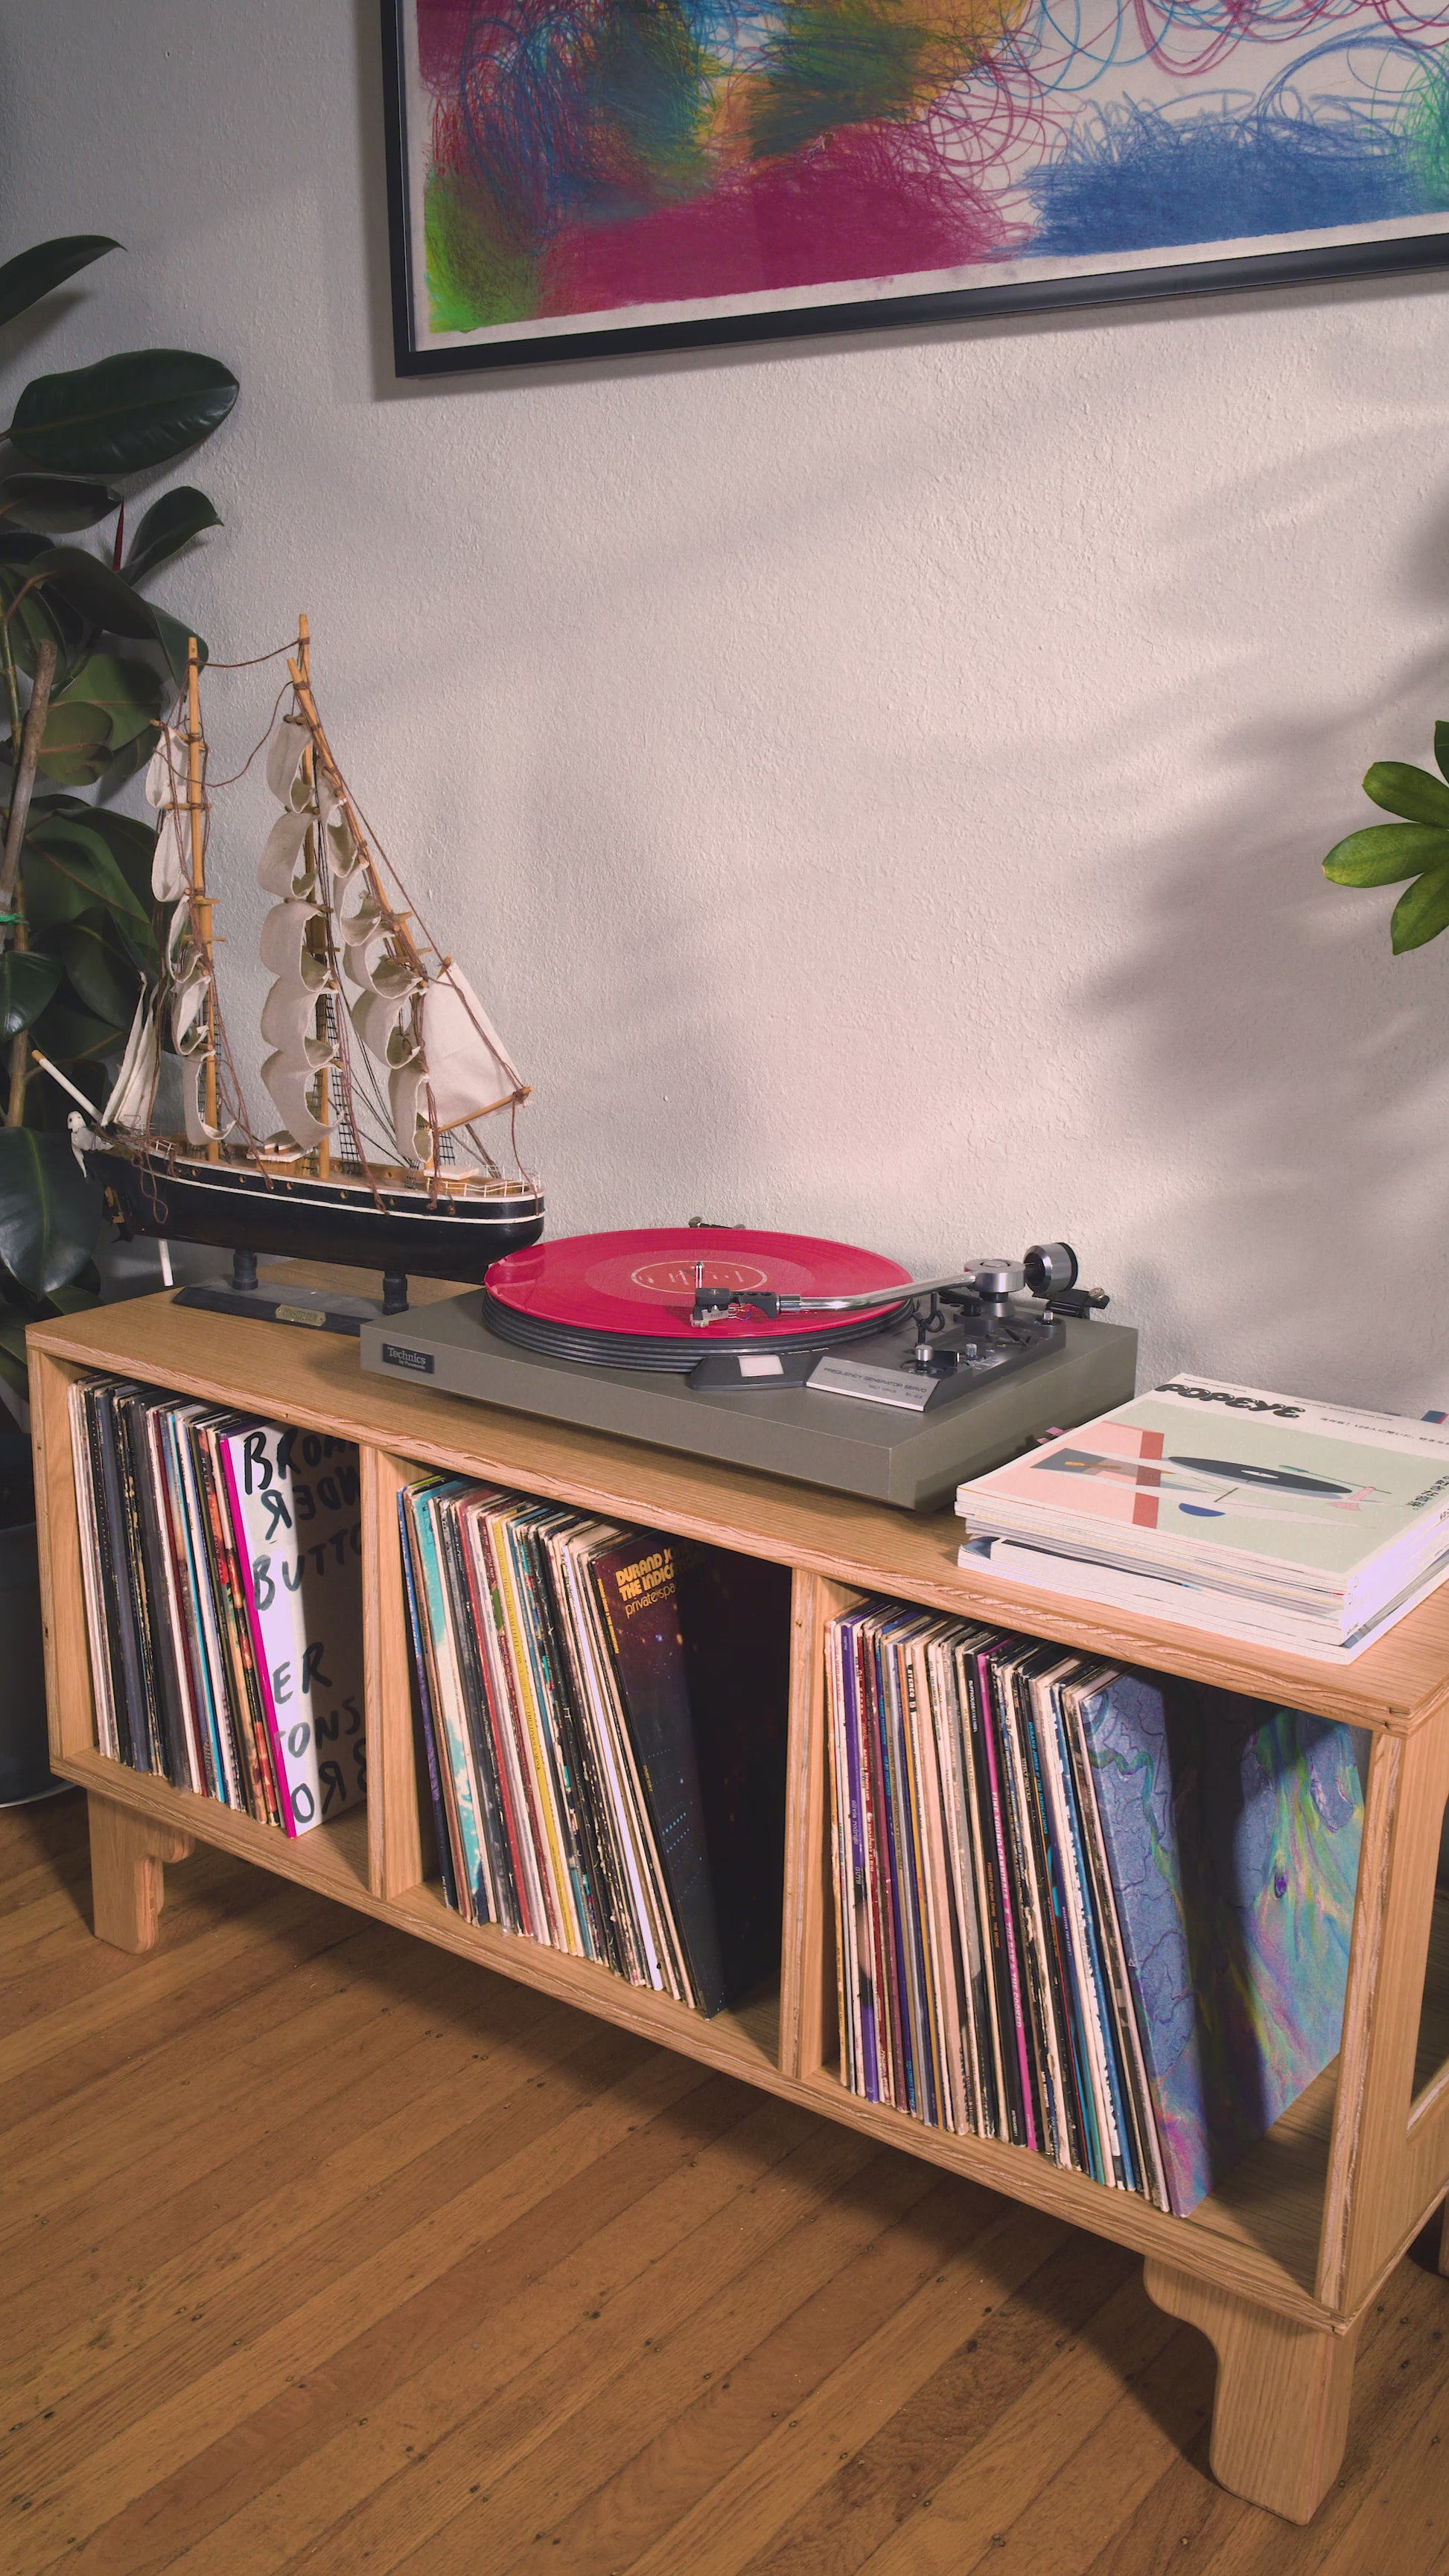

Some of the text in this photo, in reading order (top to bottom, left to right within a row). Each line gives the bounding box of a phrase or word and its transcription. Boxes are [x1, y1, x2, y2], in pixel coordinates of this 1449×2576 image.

[387, 1347, 426, 1364] Technics
[824, 1367, 927, 1393] FREQUENCY GENERATOR SERVO
[1154, 1383, 1306, 1418] POPEYE
[200, 1457, 211, 1499] MALIBU
[615, 1553, 663, 1587] DURAND
[619, 1579, 643, 1601] THE
[625, 1592, 658, 1619] private
[1028, 1721, 1037, 1750] DURAND
[1039, 1793, 1048, 1834] INDICATIONS
[994, 1814, 1003, 1846] YOUNG
[998, 1848, 1009, 1899] CANNIBALS
[1012, 1992, 1022, 2028] COOKED
